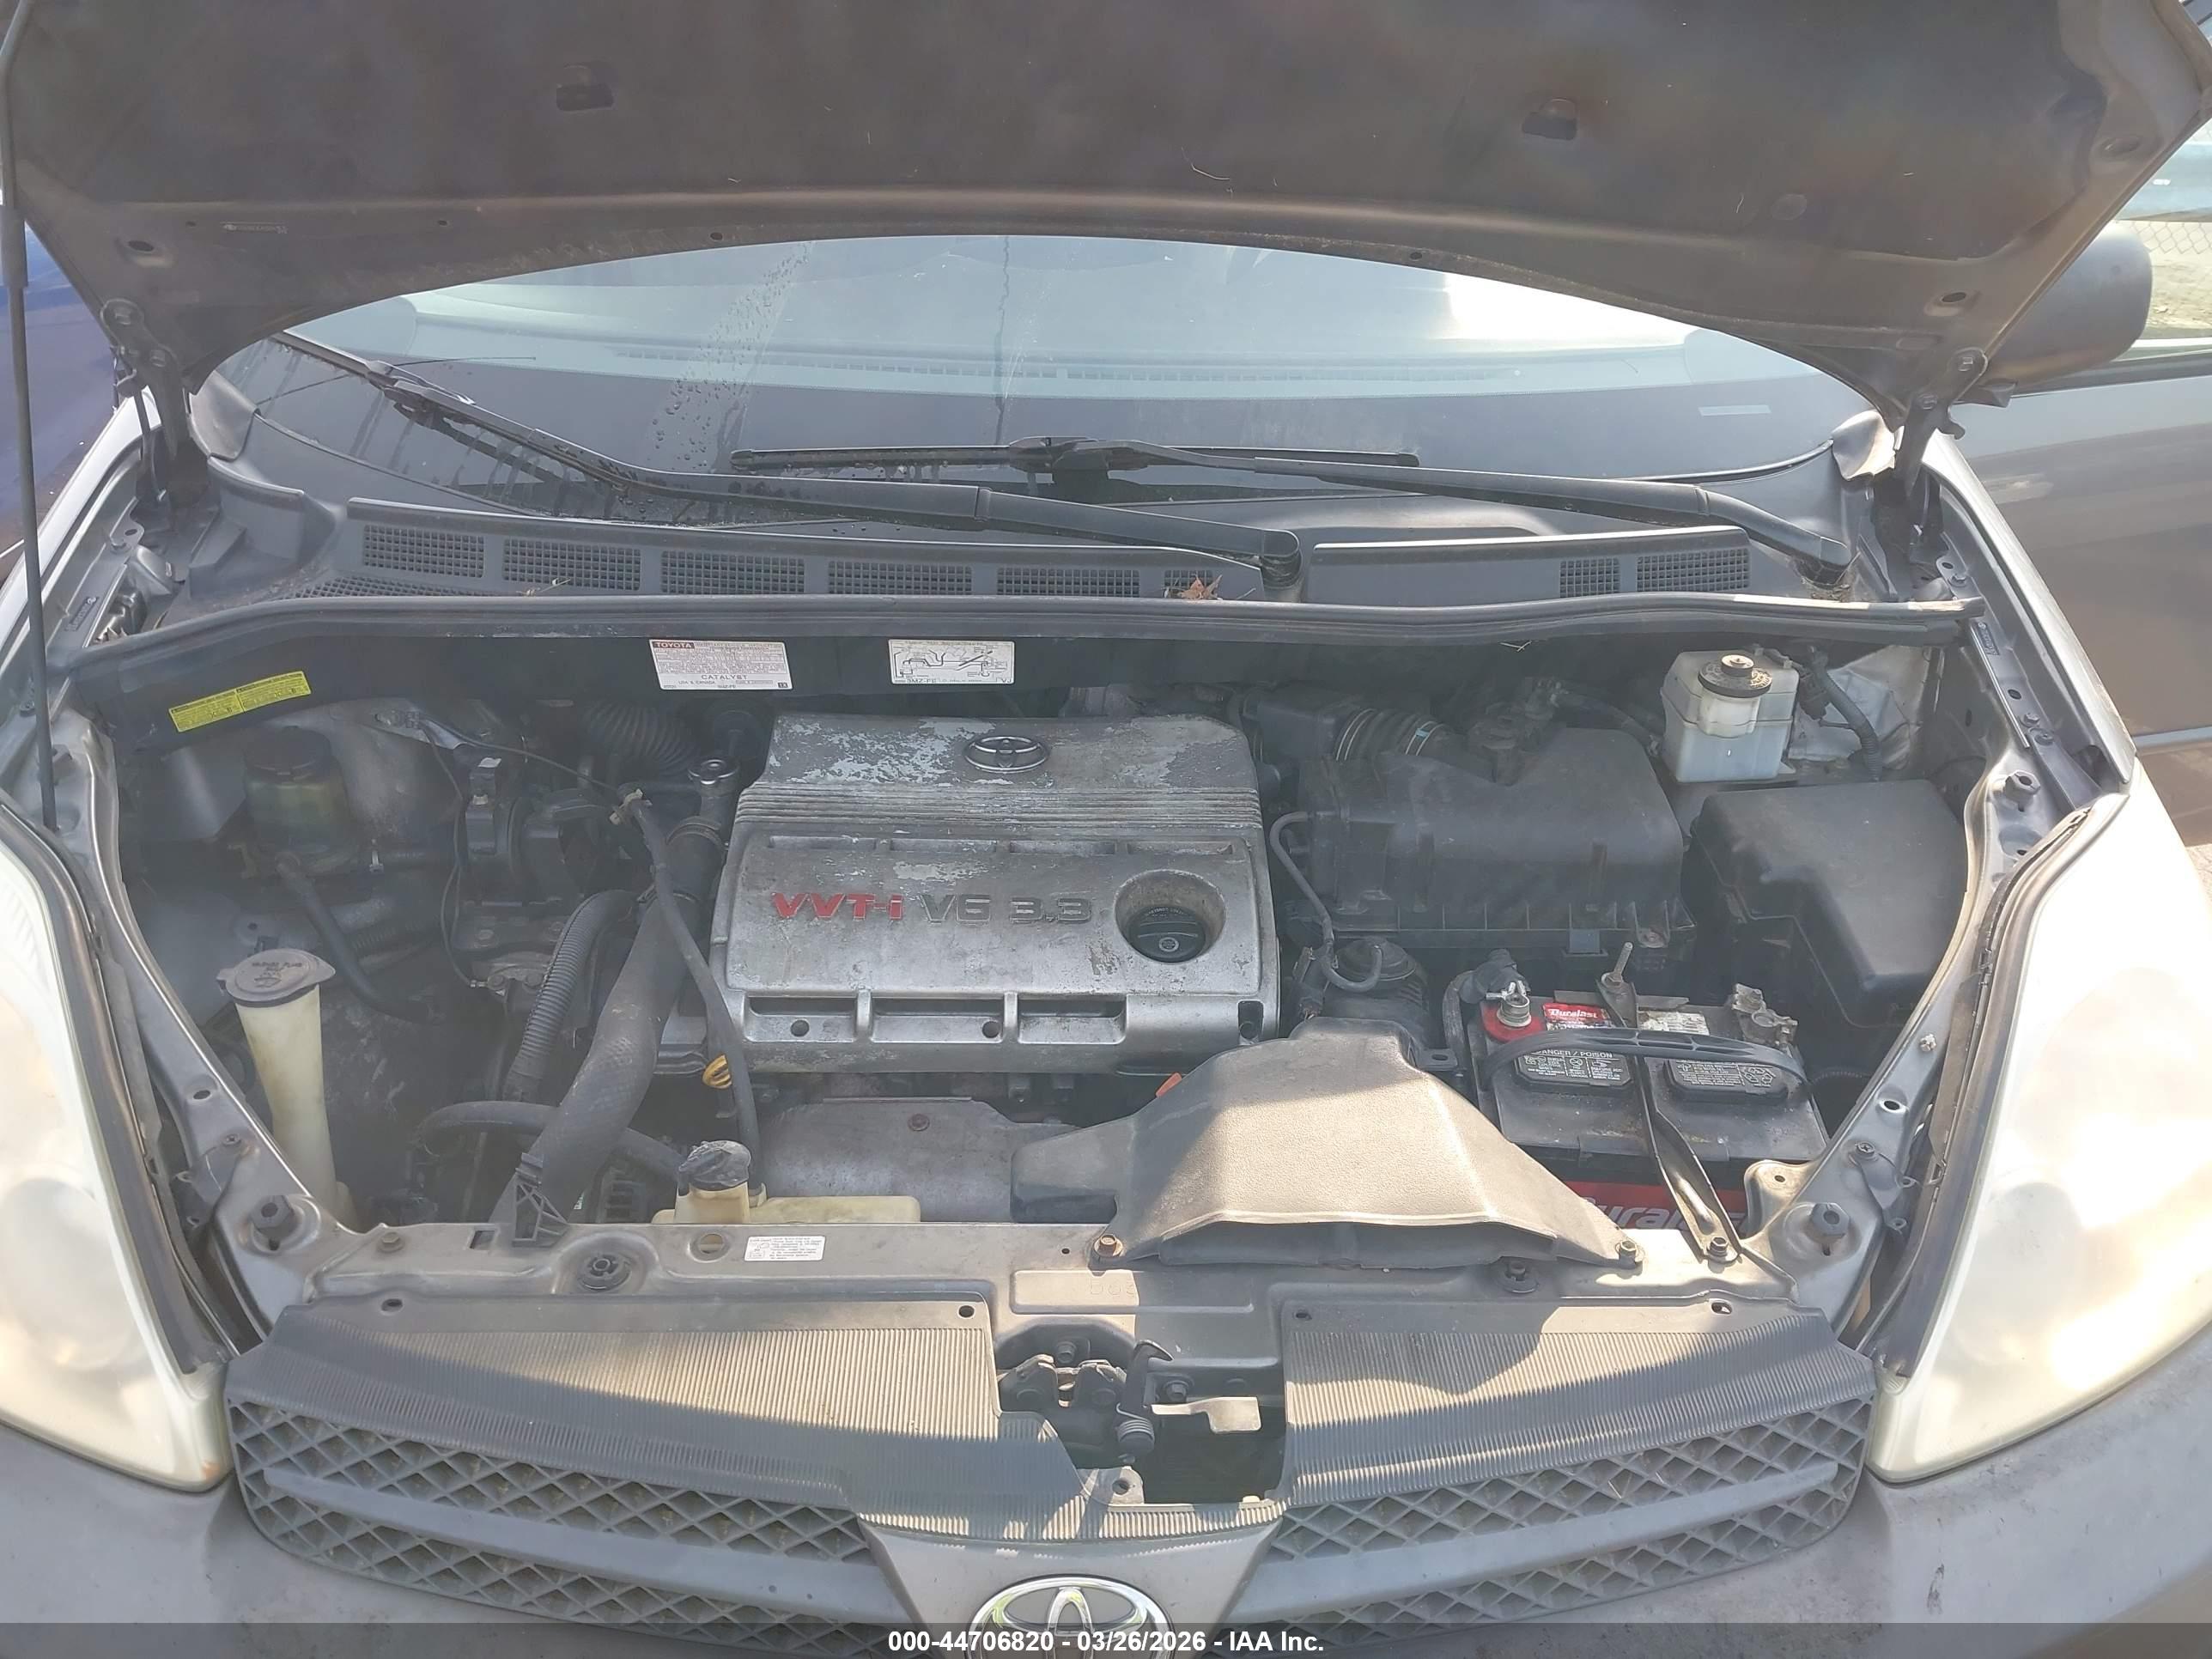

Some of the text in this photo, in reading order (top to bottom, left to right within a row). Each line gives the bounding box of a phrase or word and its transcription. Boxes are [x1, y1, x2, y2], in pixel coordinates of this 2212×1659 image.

[919, 894, 991, 925] V6
[1008, 896, 1092, 924] 3.3
[1548, 1008, 1599, 1018] Duralast
